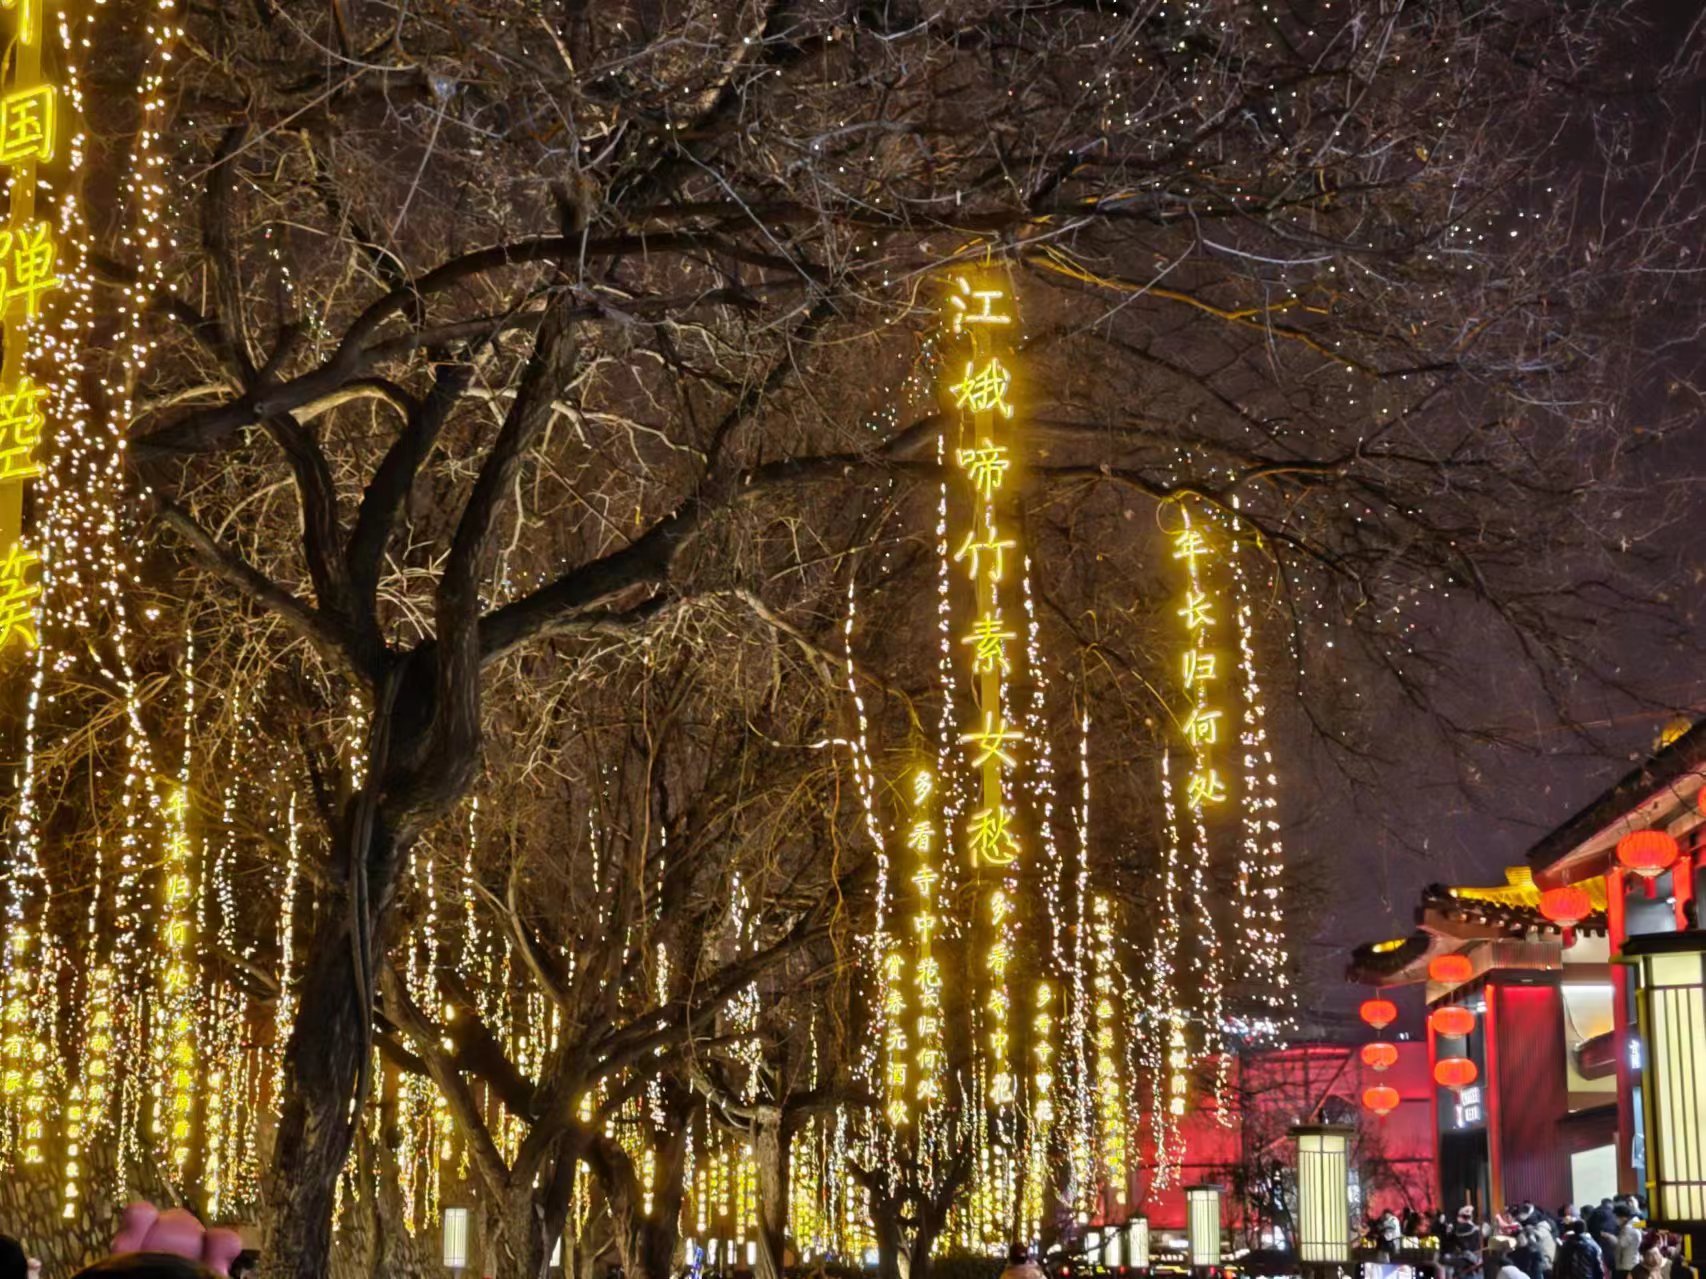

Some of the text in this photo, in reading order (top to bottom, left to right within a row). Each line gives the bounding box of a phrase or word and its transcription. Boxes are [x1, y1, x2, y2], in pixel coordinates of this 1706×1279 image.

[949, 276, 1025, 868] 江娥啼竹素女愁
[1171, 524, 1228, 808] 年长归何处
[162, 786, 193, 993] 年长归何处
[907, 769, 943, 989] 多看寺中花
